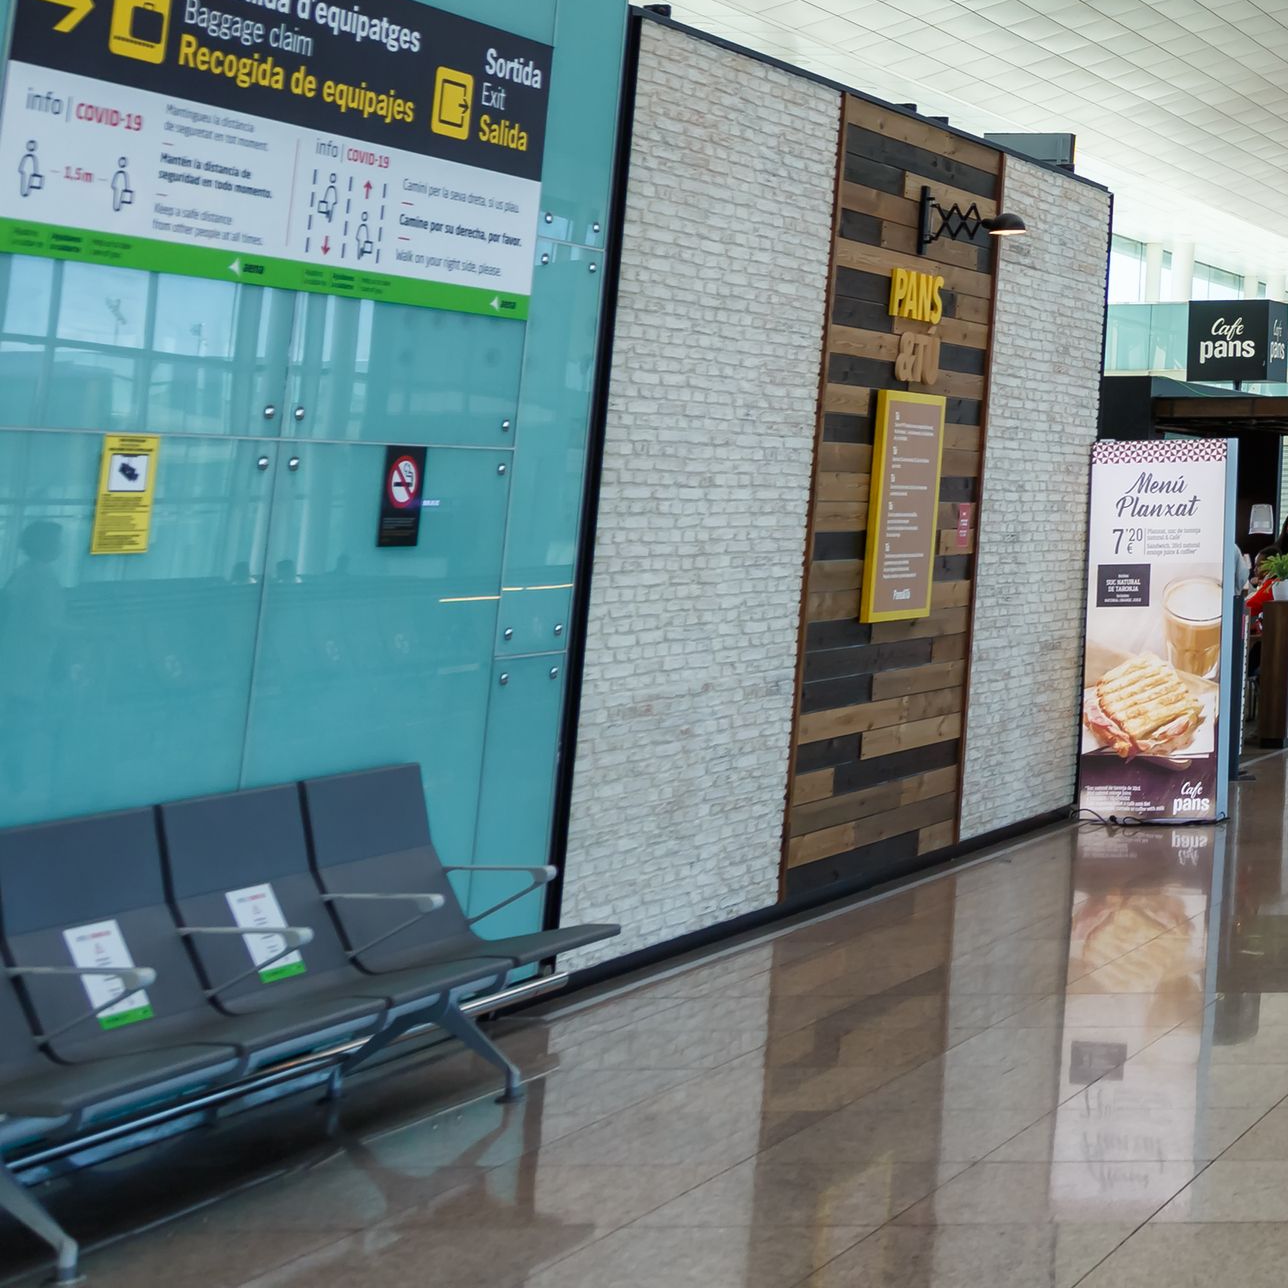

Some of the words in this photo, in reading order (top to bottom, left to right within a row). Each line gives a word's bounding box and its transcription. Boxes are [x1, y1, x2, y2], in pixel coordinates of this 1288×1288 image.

[269, 24, 313, 56] claim
[178, 34, 285, 88] Recogida
[290, 65, 317, 98] de
[322, 80, 415, 123] equipajes
[485, 48, 542, 89] Sortida
[26, 87, 64, 115] info
[75, 102, 143, 132] COVID-19
[481, 82, 506, 110] Exit
[479, 114, 528, 151] Salida
[315, 137, 338, 159] info
[346, 147, 390, 169] COVID-19
[399, 213, 428, 229] Camine
[430, 221, 444, 233] por
[444, 224, 454, 234] su
[488, 232, 501, 243] por
[502, 233, 522, 247] favor.
[242, 263, 264, 274] aena
[889, 267, 945, 325] PANS
[1211, 317, 1244, 340] Cafe
[1199, 340, 1255, 364] pans
[1269, 341, 1285, 363] pans
[1125, 472, 1187, 494] Menú
[1115, 495, 1201, 518] Planxat
[1173, 797, 1210, 814] pans
